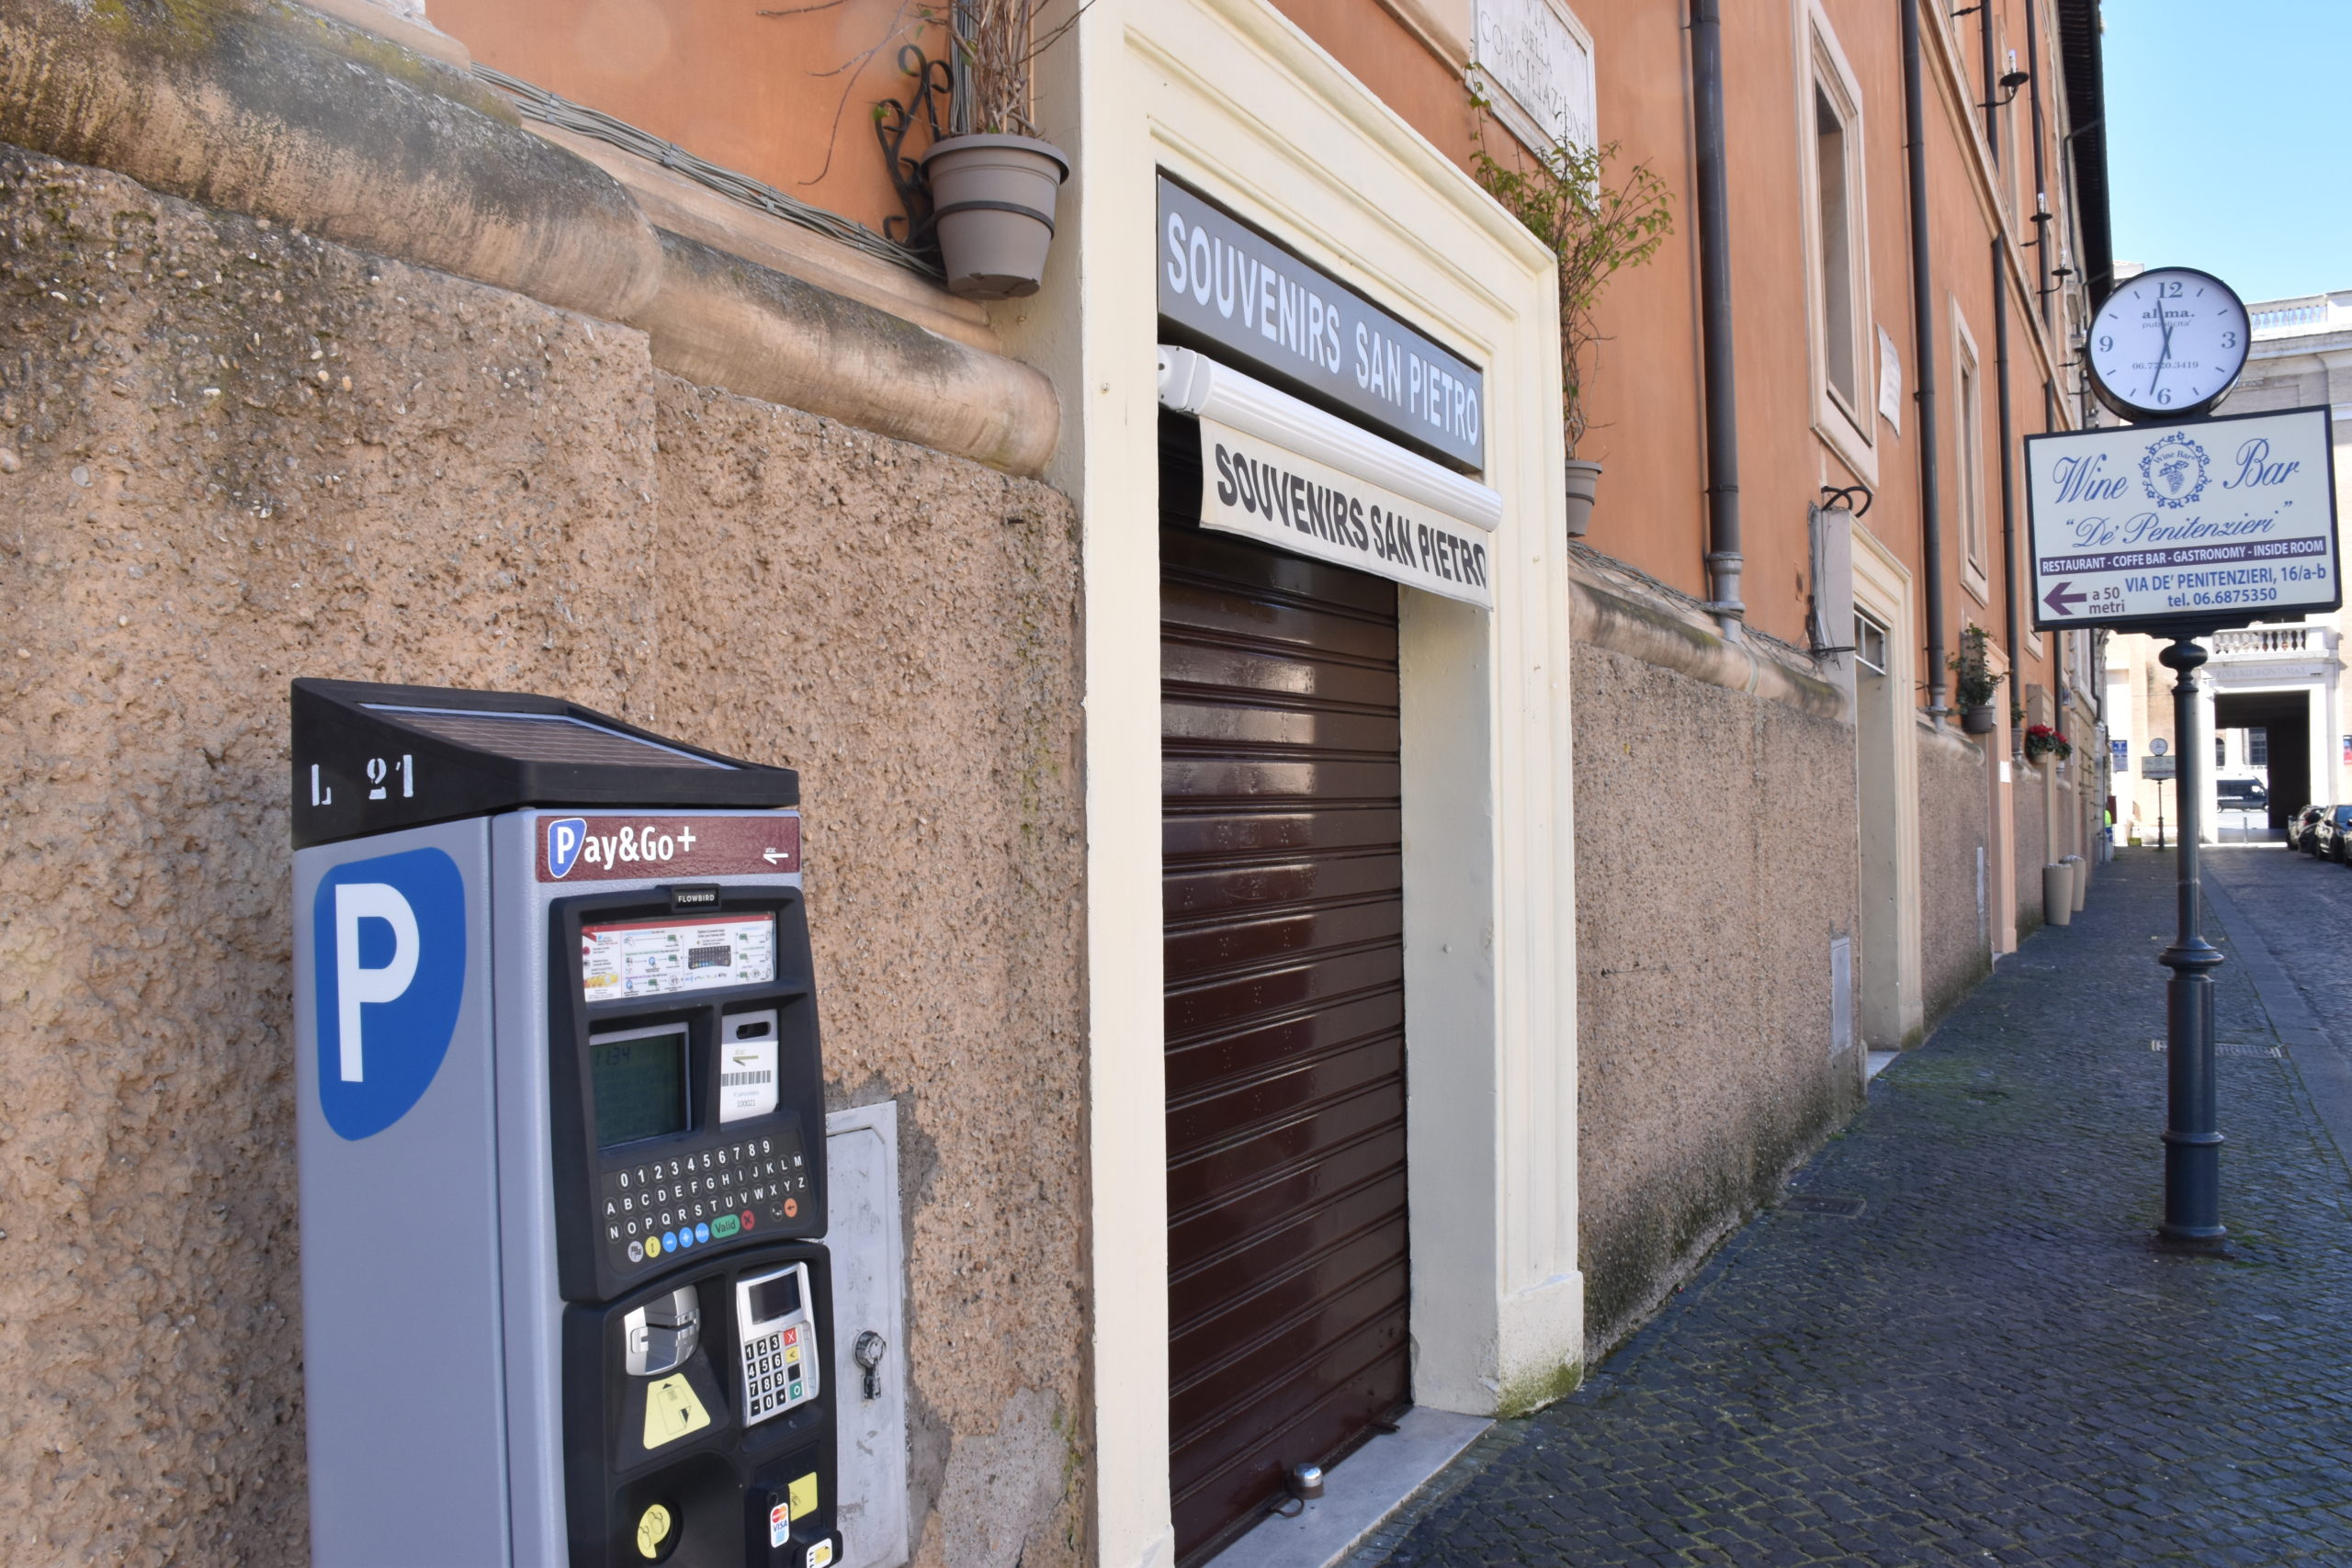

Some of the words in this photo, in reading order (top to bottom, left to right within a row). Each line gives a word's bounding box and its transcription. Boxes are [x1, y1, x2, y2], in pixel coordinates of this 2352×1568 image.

[1521, 21, 1553, 73] DELLA
[2156, 281, 2183, 299] 12
[1167, 211, 1341, 374] SOUVENIRS
[1355, 320, 1402, 407] SAN
[1409, 351, 1479, 446] PIETRO
[2099, 335, 2113, 352] 9
[2221, 332, 2236, 349] 3
[2157, 389, 2171, 405] 6
[2153, 451, 2175, 464] Wine
[2052, 453, 2130, 504] Wine
[2223, 438, 2301, 489] Bar
[1215, 443, 1370, 552] SOUVENIRS
[1371, 504, 1419, 569] SAN
[1418, 525, 1487, 590] PIETRO
[2042, 557, 2106, 573] RESTAURANT
[2113, 554, 2143, 568] COFFE
[2146, 552, 2166, 565] BAR
[2173, 546, 2246, 563] GASTRONOMY
[2254, 542, 2289, 557] INSIDE
[2290, 540, 2324, 553] ROOM
[2125, 576, 2149, 592] VIA
[2177, 568, 2278, 589] PENITENZIERI,
[2281, 563, 2326, 581] 16/a-b
[2092, 591, 2100, 601] a
[2104, 587, 2120, 600] 50
[2167, 592, 2189, 607] tel.
[2193, 588, 2277, 605] 06.6875350
[2089, 600, 2125, 615] metri
[311, 763, 332, 807] L
[367, 754, 413, 800] 21
[678, 894, 715, 903] FLOWBIRD
[335, 883, 420, 1082] P
[621, 1173, 628, 1187] 0
[639, 1169, 645, 1182] 1
[654, 1166, 662, 1179] 2
[671, 1161, 679, 1175] 3
[687, 1157, 695, 1171] 4
[703, 1154, 710, 1168] 5
[718, 1151, 726, 1164] 6
[733, 1147, 741, 1160] 7
[749, 1144, 755, 1156] 8
[763, 1141, 770, 1153] 9
[607, 1202, 616, 1214] A
[624, 1198, 632, 1210] B
[641, 1194, 650, 1205] C
[658, 1190, 666, 1201] D
[675, 1186, 683, 1197] E
[691, 1181, 697, 1193] F
[707, 1178, 715, 1189] G
[722, 1174, 729, 1185] H
[753, 1167, 759, 1178] J
[766, 1163, 774, 1174] K
[781, 1160, 787, 1170] L
[794, 1156, 802, 1167] M
[610, 1226, 619, 1239] N
[628, 1222, 636, 1234] O
[645, 1217, 652, 1229] P
[662, 1213, 671, 1225] Q
[678, 1209, 687, 1221] R
[695, 1204, 702, 1216] S
[710, 1201, 717, 1212] T
[726, 1196, 733, 1207] U
[741, 1192, 748, 1203] V
[754, 1188, 763, 1200] W
[770, 1184, 777, 1196] X
[784, 1180, 790, 1191] Y
[798, 1177, 805, 1188] Z
[715, 1220, 736, 1234] Valid
[747, 1347, 752, 1358] 1
[760, 1342, 765, 1353] 2
[773, 1337, 778, 1348] 3
[749, 1365, 754, 1376] 4
[763, 1360, 768, 1371] 5
[775, 1355, 780, 1366] 6
[751, 1383, 756, 1395] 7
[764, 1379, 770, 1390] 8
[777, 1373, 783, 1384] 9
[766, 1397, 772, 1408] 0
[773, 1519, 787, 1532] VISA
